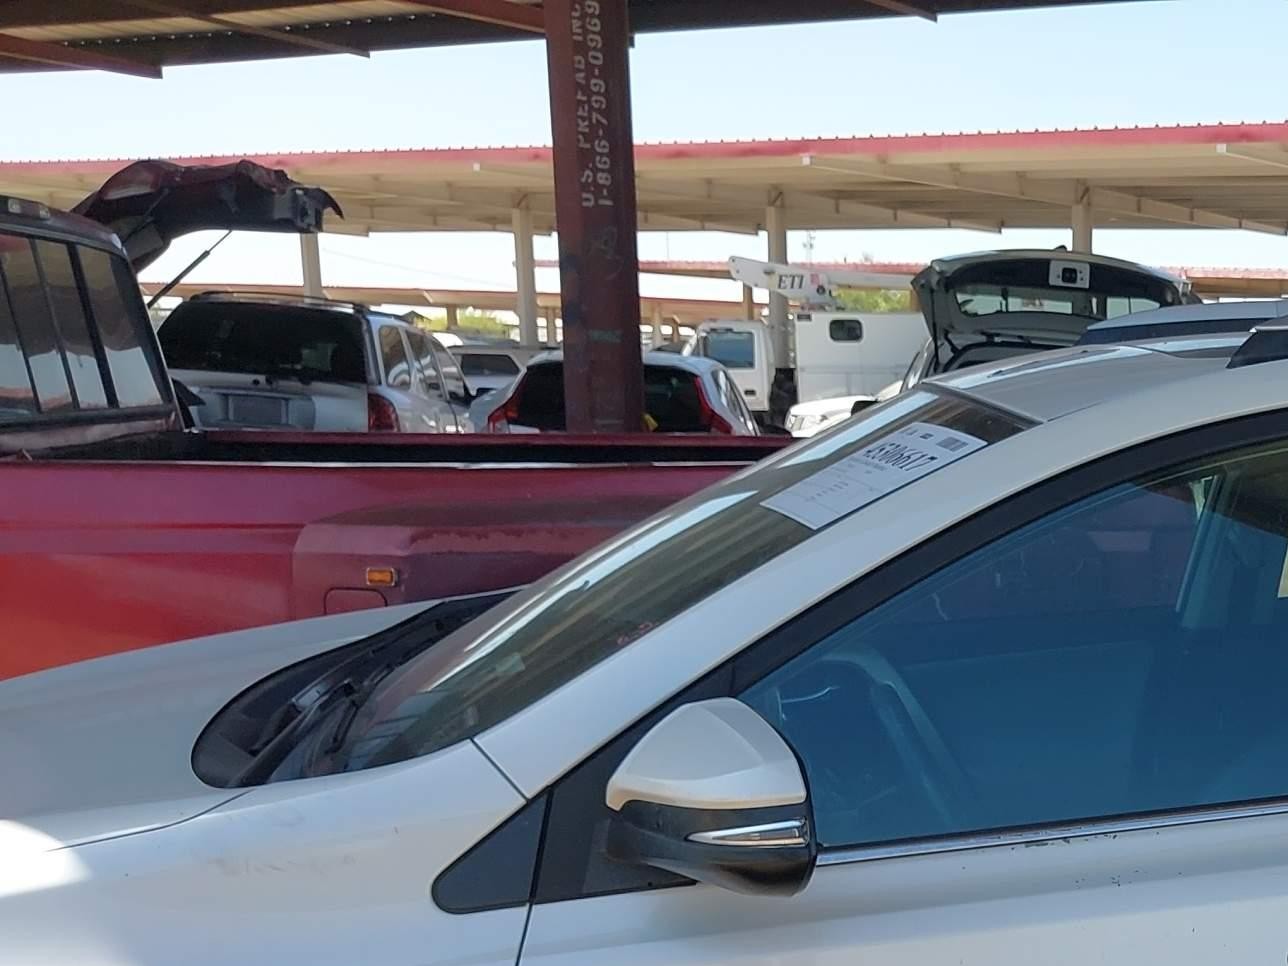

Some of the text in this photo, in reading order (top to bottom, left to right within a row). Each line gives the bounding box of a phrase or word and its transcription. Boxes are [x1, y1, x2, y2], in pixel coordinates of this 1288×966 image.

[574, 55, 592, 149] PREFAB
[584, 0, 614, 207] 1-866-799-0969
[581, 162, 595, 208] U.S.
[777, 273, 805, 290] ETI
